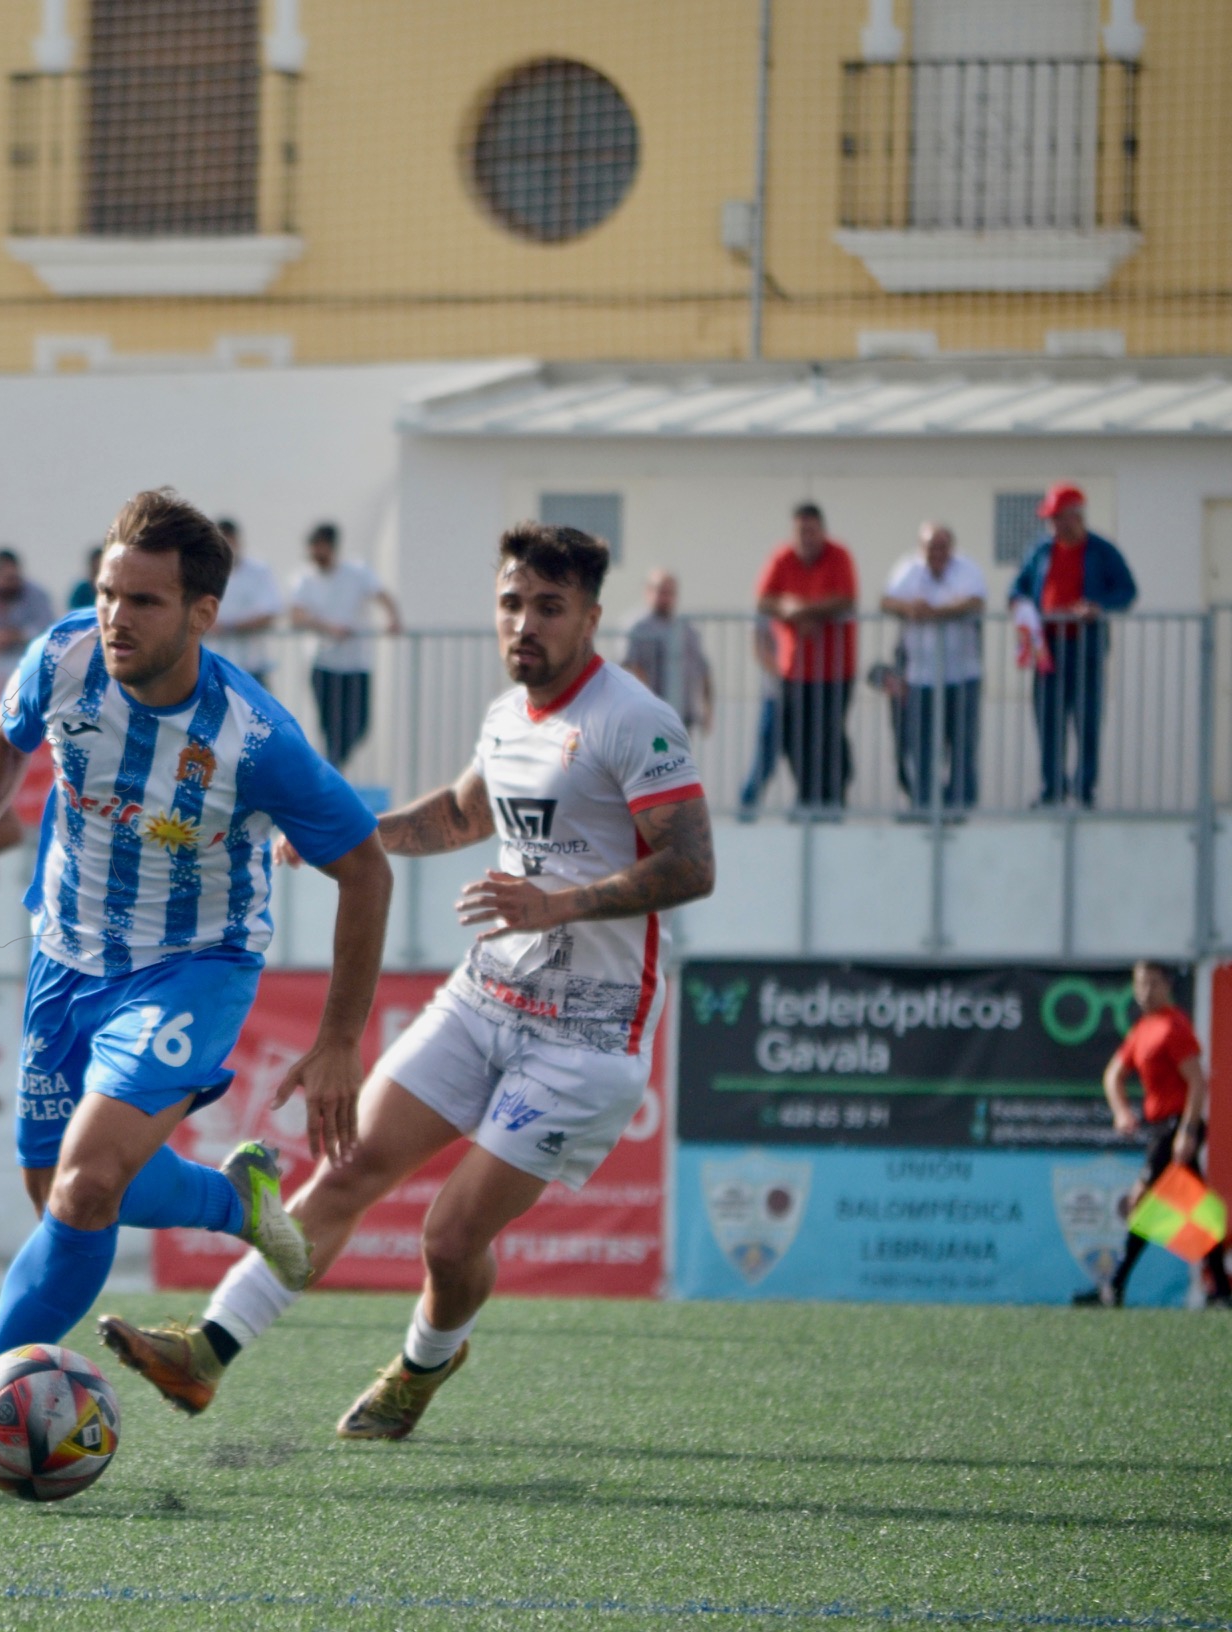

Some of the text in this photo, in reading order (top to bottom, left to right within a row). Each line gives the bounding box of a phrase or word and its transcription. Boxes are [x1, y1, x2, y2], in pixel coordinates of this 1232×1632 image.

[760, 979, 1023, 1037] federópticos
[131, 1005, 195, 1068] 16
[756, 1032, 891, 1074] Gavala
[18, 1071, 71, 1096] DERA
[17, 1098, 77, 1121] PLEO
